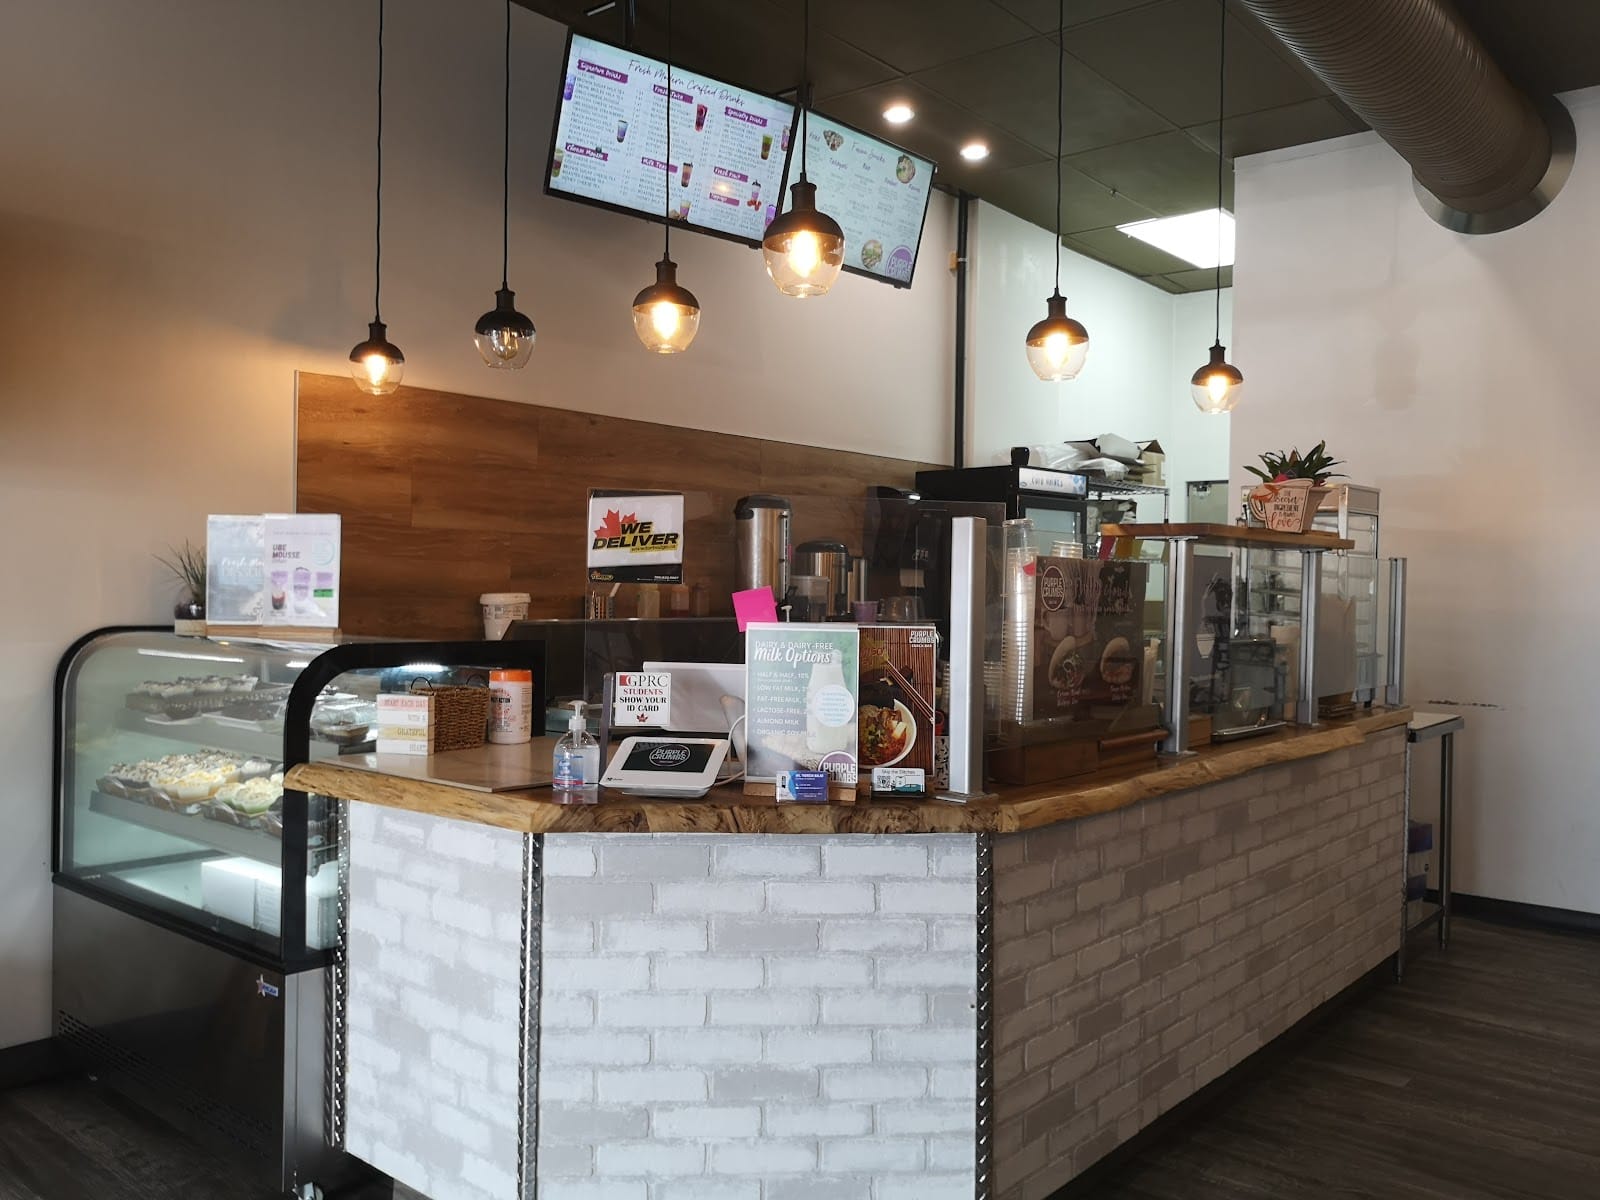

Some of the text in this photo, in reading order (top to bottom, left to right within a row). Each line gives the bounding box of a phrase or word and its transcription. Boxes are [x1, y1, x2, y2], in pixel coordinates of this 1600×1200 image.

[627, 60, 651, 75] Fresh
[687, 80, 717, 97] Crafted
[719, 90, 745, 106] Drinks
[621, 521, 653, 535] WE
[592, 532, 679, 550] DELIVER
[272, 551, 301, 559] MOUSSE
[911, 630, 934, 638] PURPLE
[756, 640, 833, 650] DAIRY & DAIRY-FREE
[754, 646, 832, 669] Milk Options
[627, 675, 668, 687] GPRC
[619, 696, 667, 704] SHOW YOUR
[757, 695, 784, 703] FAT-FREE
[397, 728, 426, 737] GRATEFUL
[651, 753, 687, 761] CRUMBS
[823, 762, 857, 773] PURPLE
